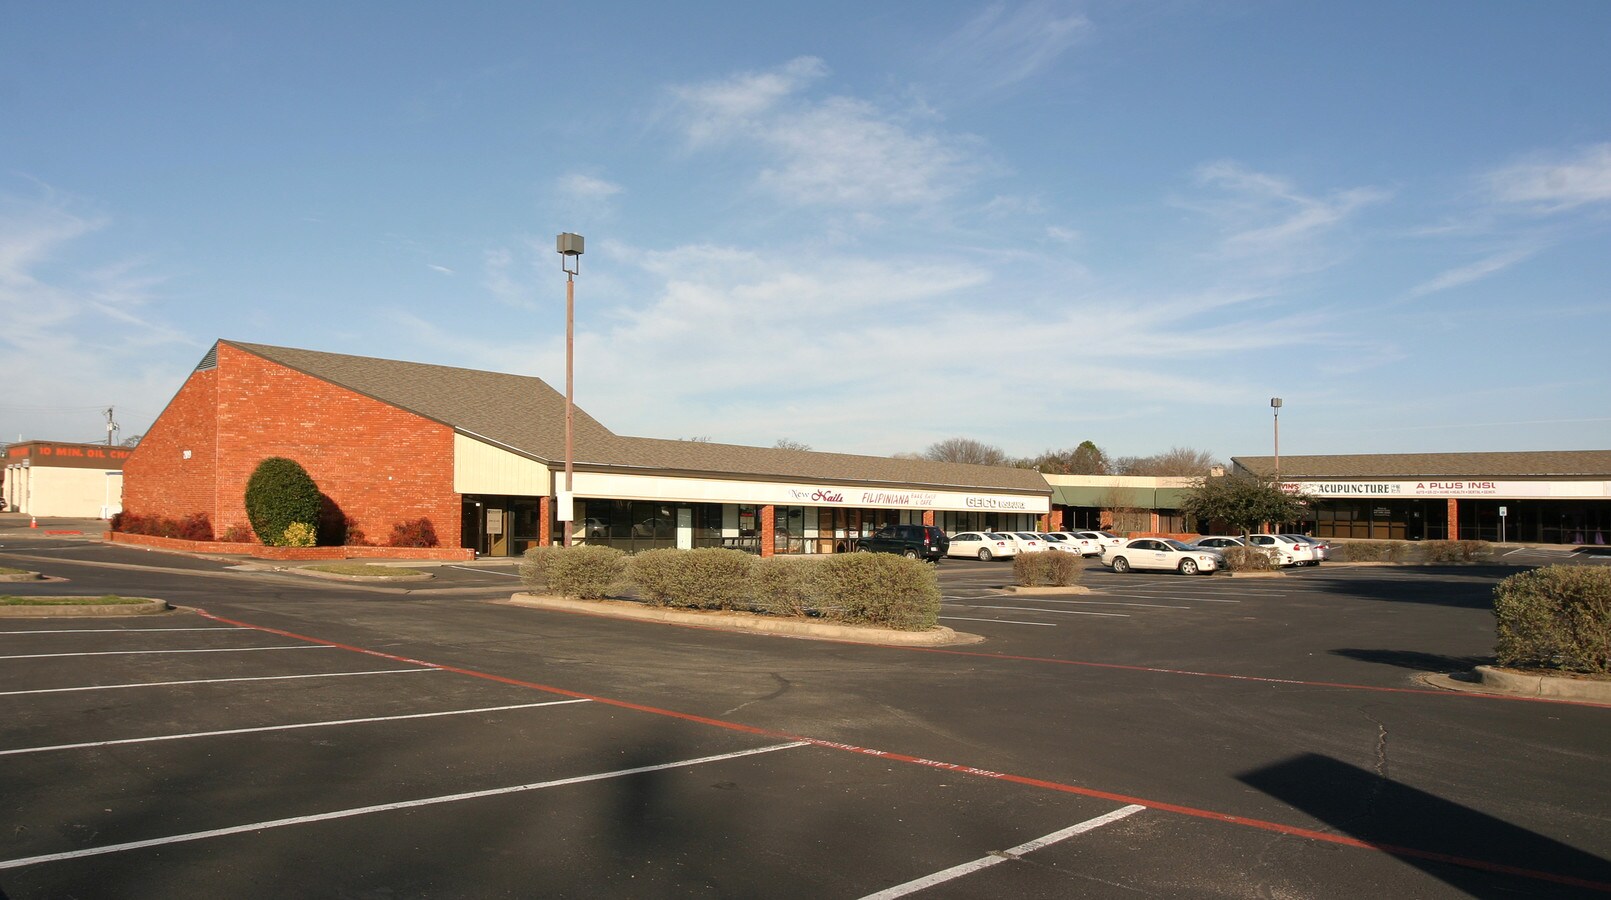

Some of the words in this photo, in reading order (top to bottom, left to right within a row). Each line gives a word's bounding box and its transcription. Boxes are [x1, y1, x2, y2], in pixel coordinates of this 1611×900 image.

[40, 447, 52, 456] 10
[56, 447, 83, 457] MIN.
[87, 449, 106, 459] OIL
[1318, 483, 1390, 494] ACUPUNCTURE
[788, 489, 810, 499] New
[811, 489, 844, 502] Nails
[861, 492, 910, 505] FILIPINIANA
[965, 497, 996, 508] GEICO
